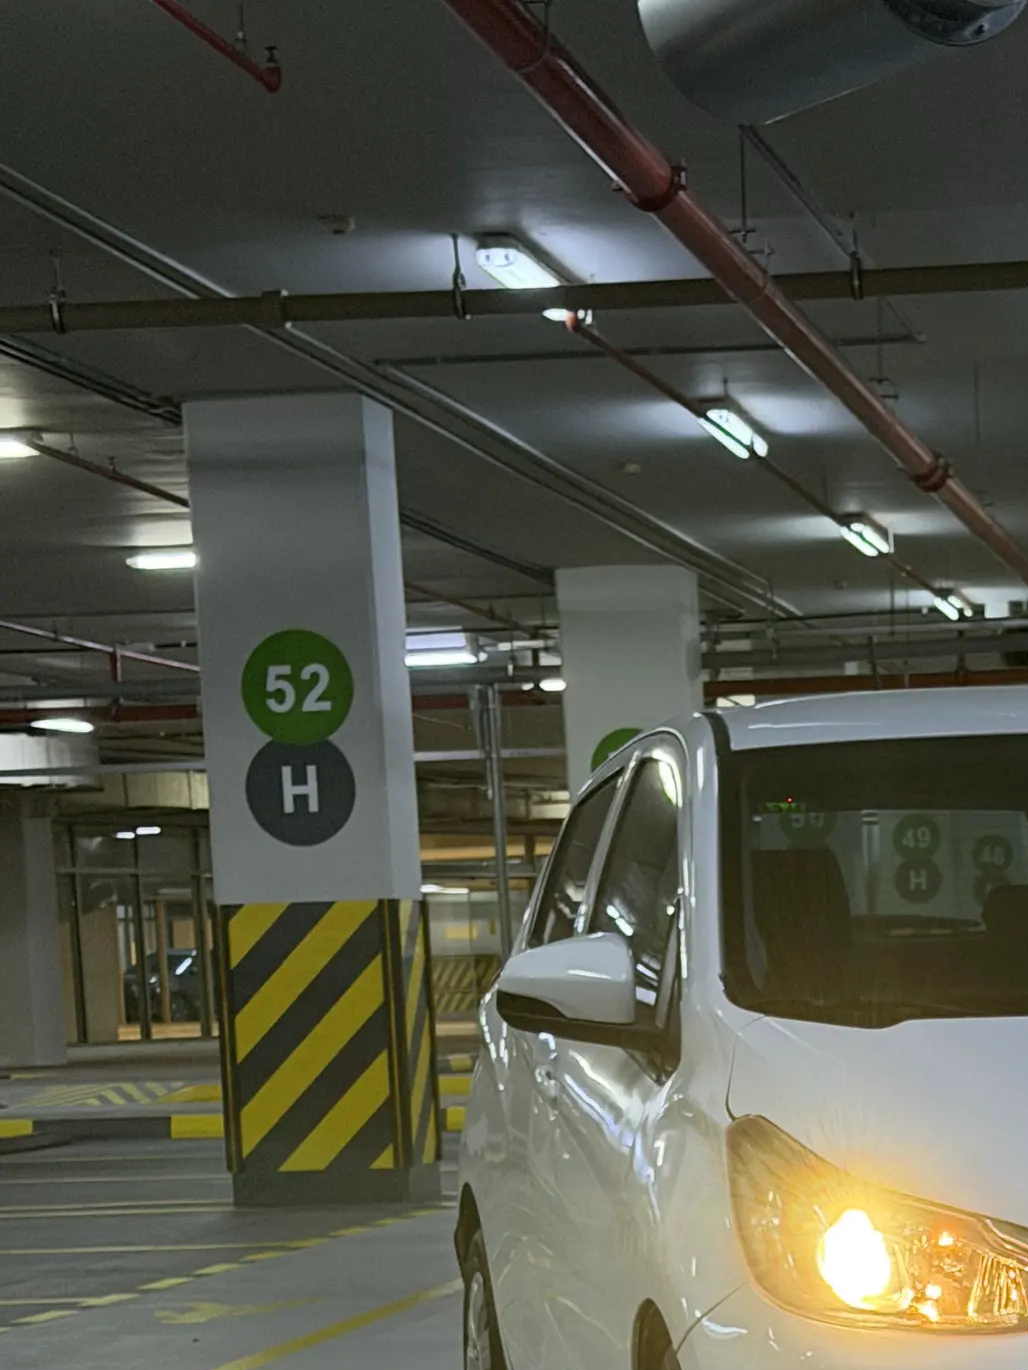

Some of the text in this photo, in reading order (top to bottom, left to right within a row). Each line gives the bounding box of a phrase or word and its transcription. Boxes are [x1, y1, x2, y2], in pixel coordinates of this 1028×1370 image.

[265, 663, 332, 713] 52
[281, 765, 319, 813] H
[902, 825, 932, 849] 49
[909, 869, 927, 892] H
